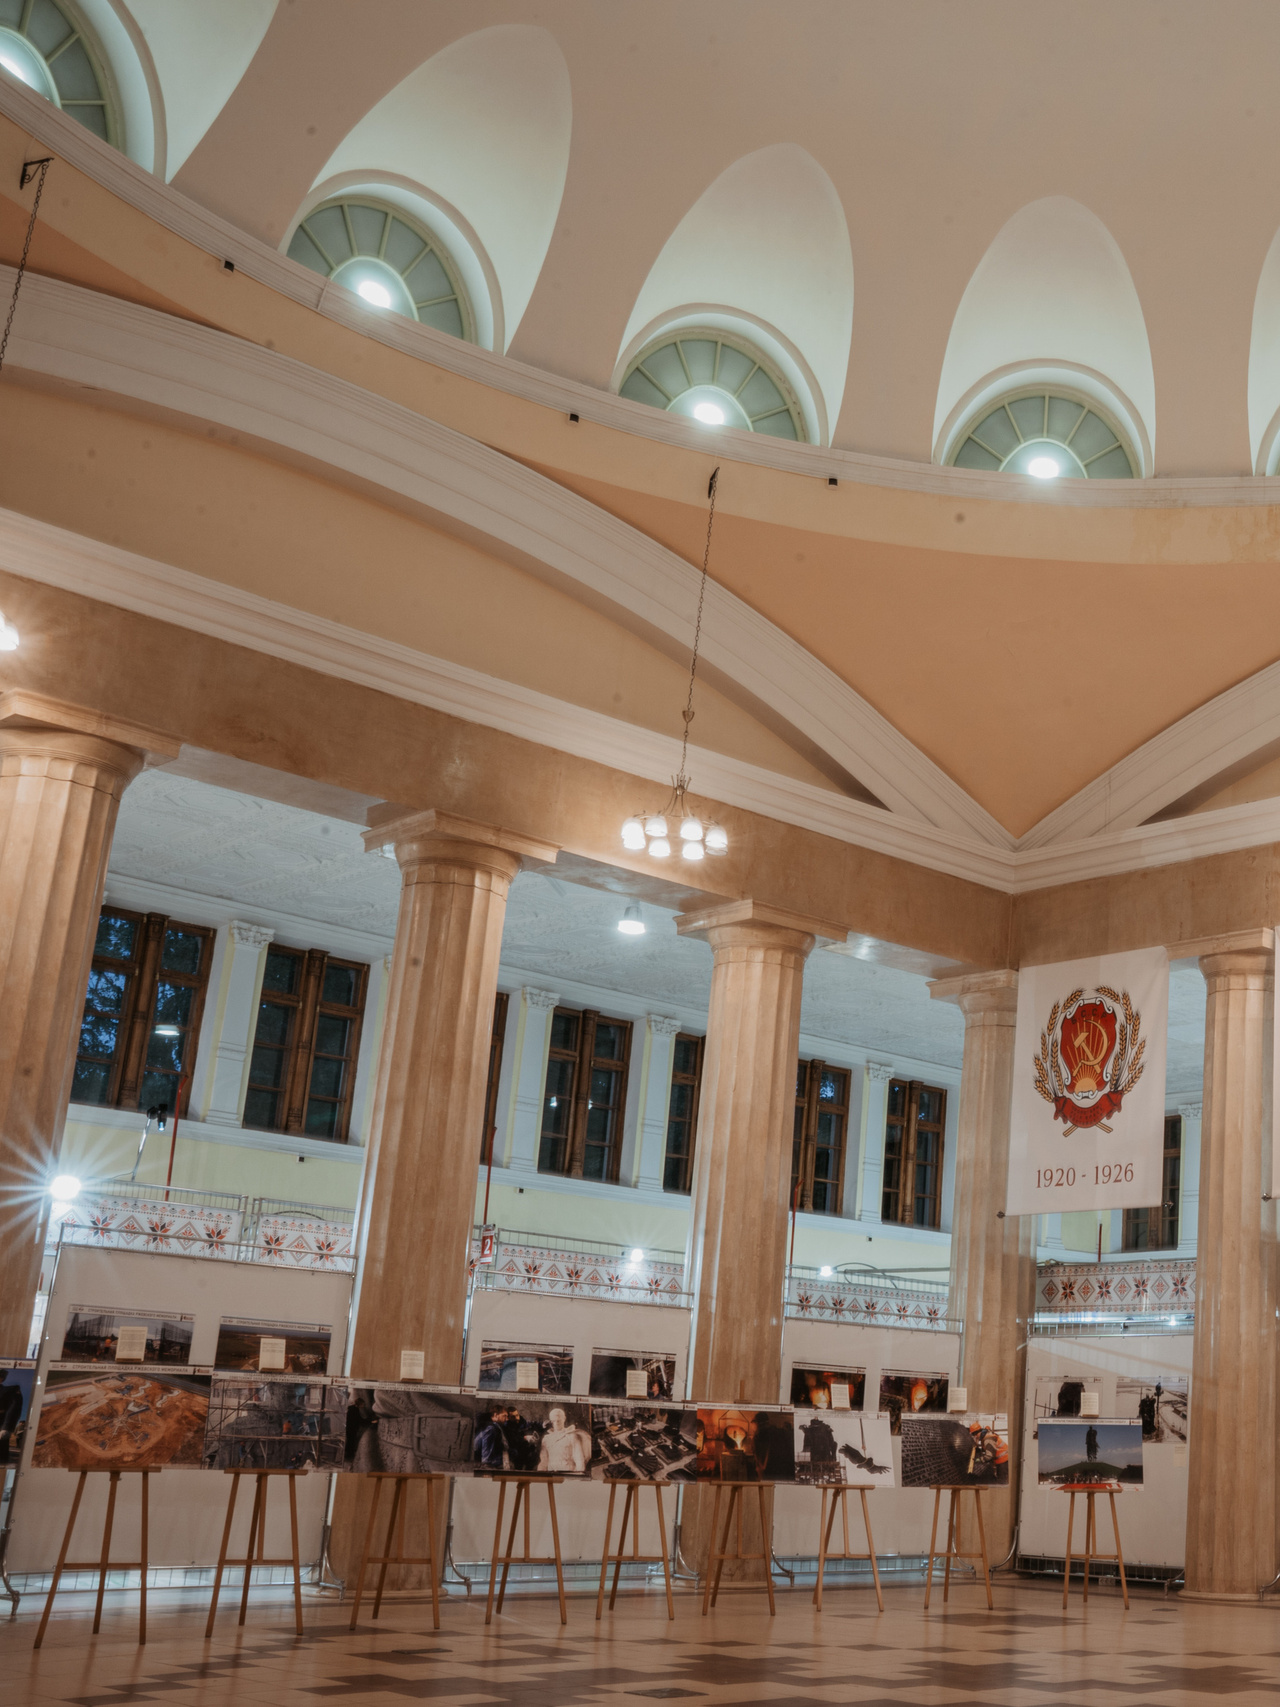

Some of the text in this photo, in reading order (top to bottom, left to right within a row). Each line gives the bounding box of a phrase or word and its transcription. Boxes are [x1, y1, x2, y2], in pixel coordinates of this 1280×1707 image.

[1036, 1167, 1076, 1188] 1920
[1094, 1162, 1134, 1185] 1926
[483, 1238, 491, 1255] 2
